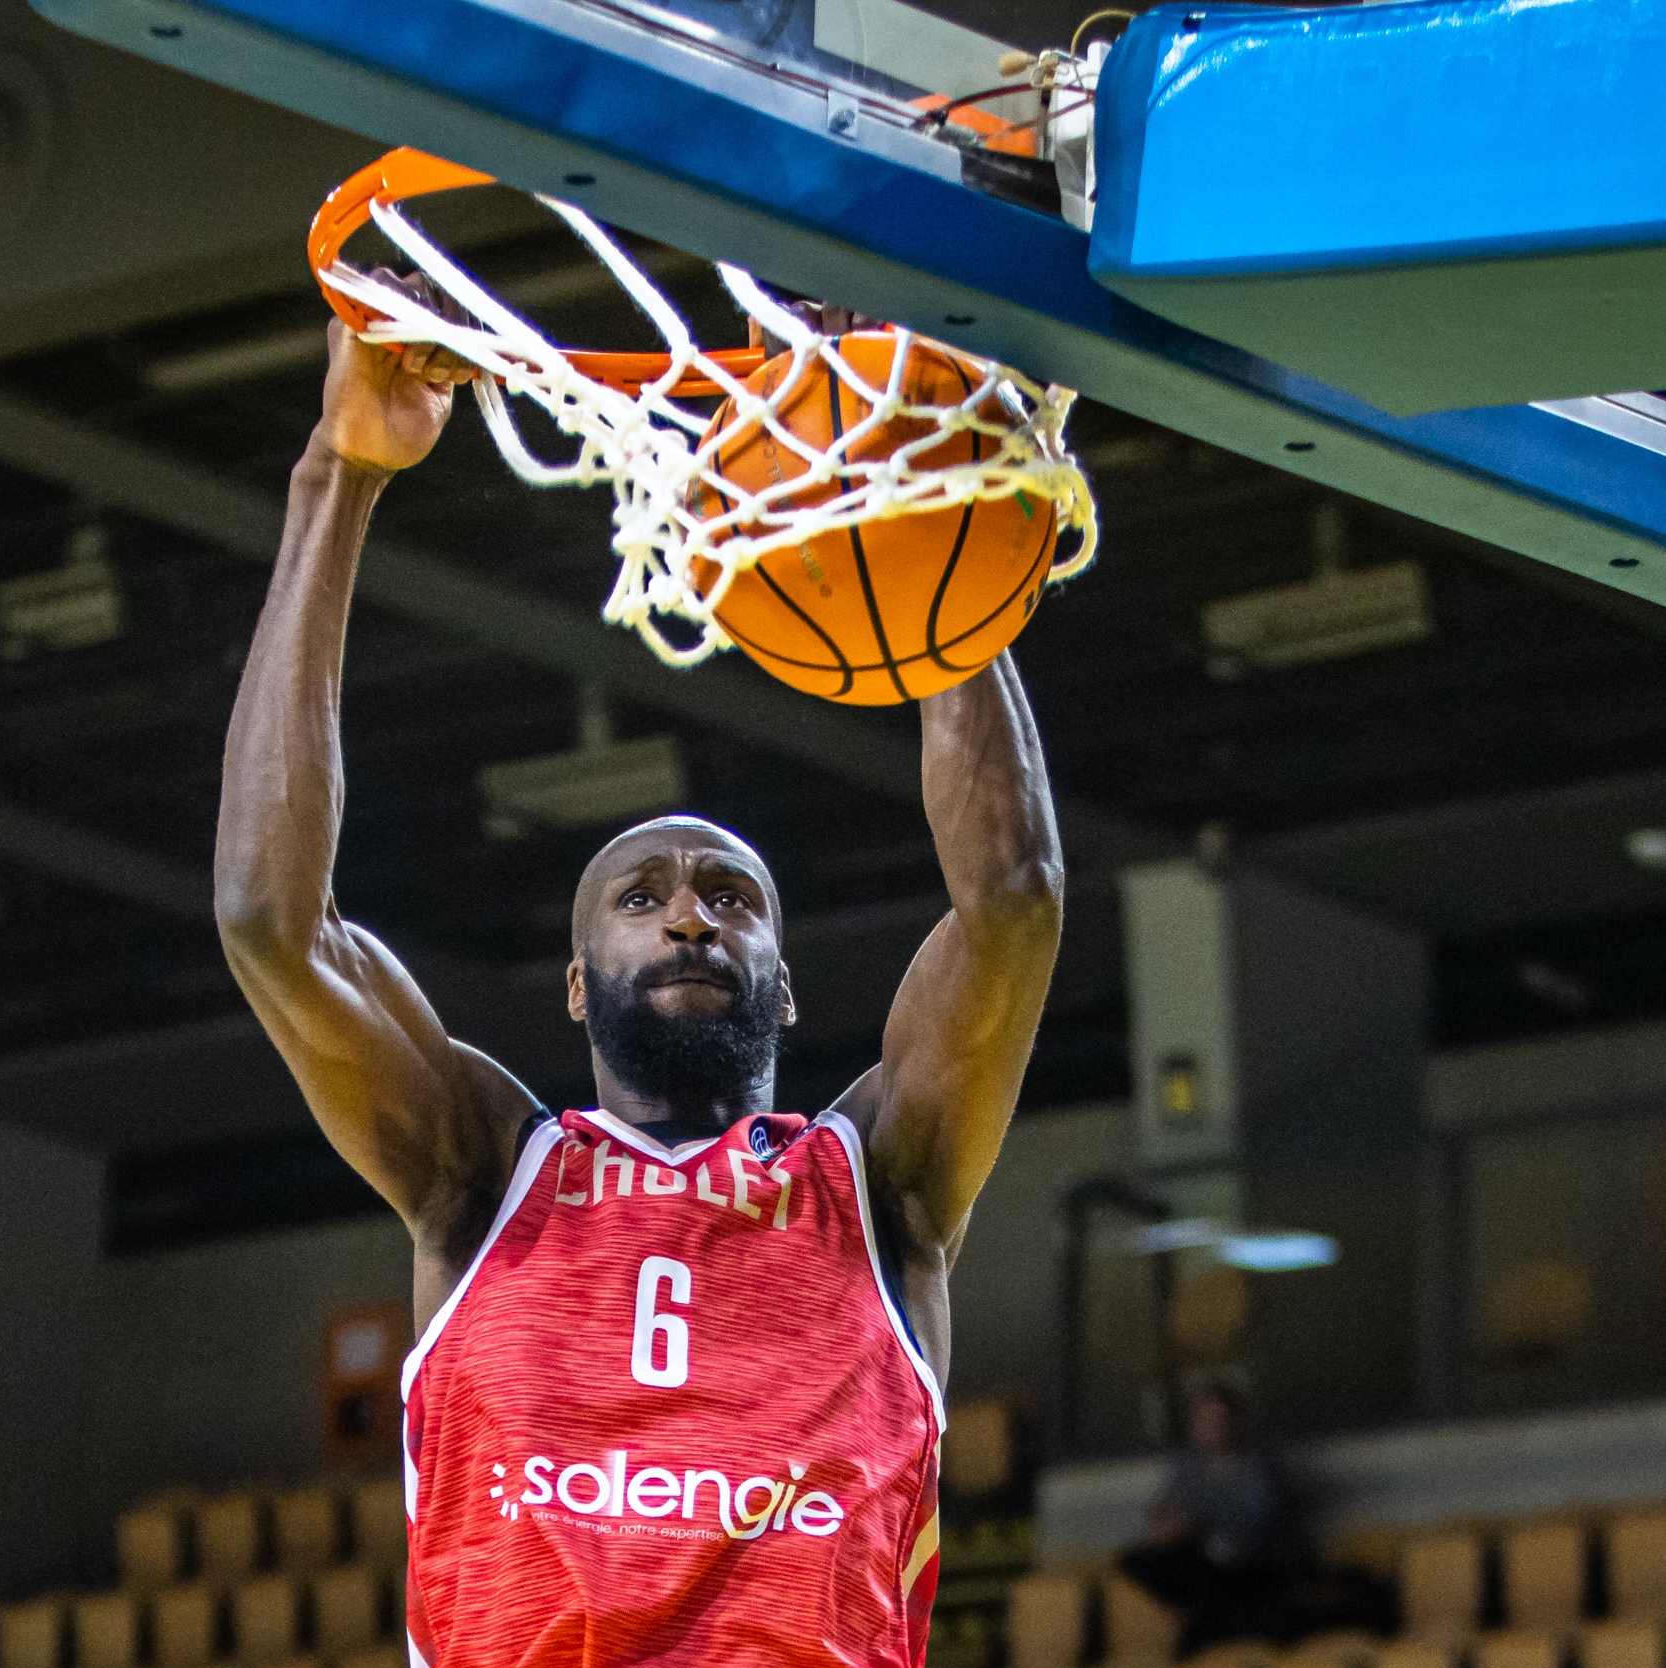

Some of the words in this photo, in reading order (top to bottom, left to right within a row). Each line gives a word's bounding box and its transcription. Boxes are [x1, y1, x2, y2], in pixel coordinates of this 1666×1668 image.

[631, 1256, 692, 1388] 6
[519, 1449, 845, 1541] solengie
[533, 1510, 559, 1523] otre
[619, 1523, 657, 1536] notre
